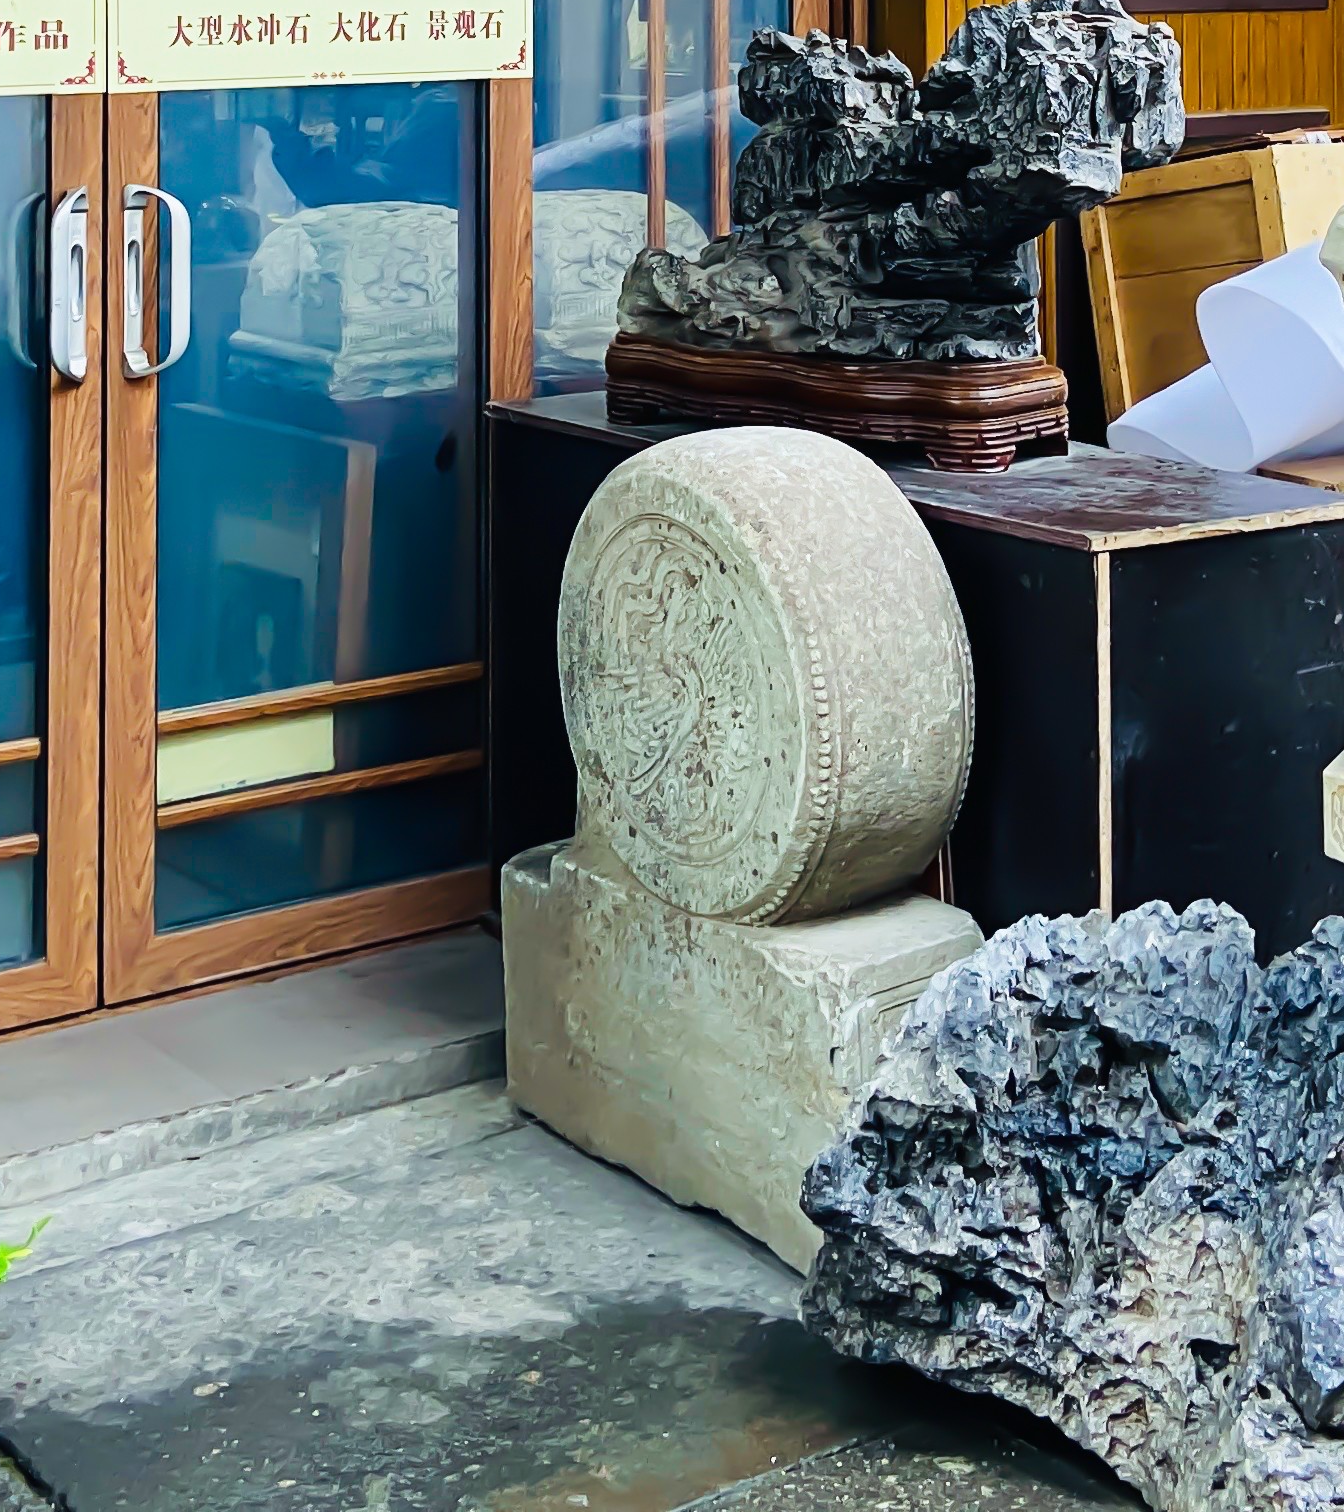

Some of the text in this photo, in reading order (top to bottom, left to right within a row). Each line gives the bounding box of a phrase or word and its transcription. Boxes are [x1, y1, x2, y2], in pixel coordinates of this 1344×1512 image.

[168, 9, 505, 48] 大型水冲石 大化石 景观石
